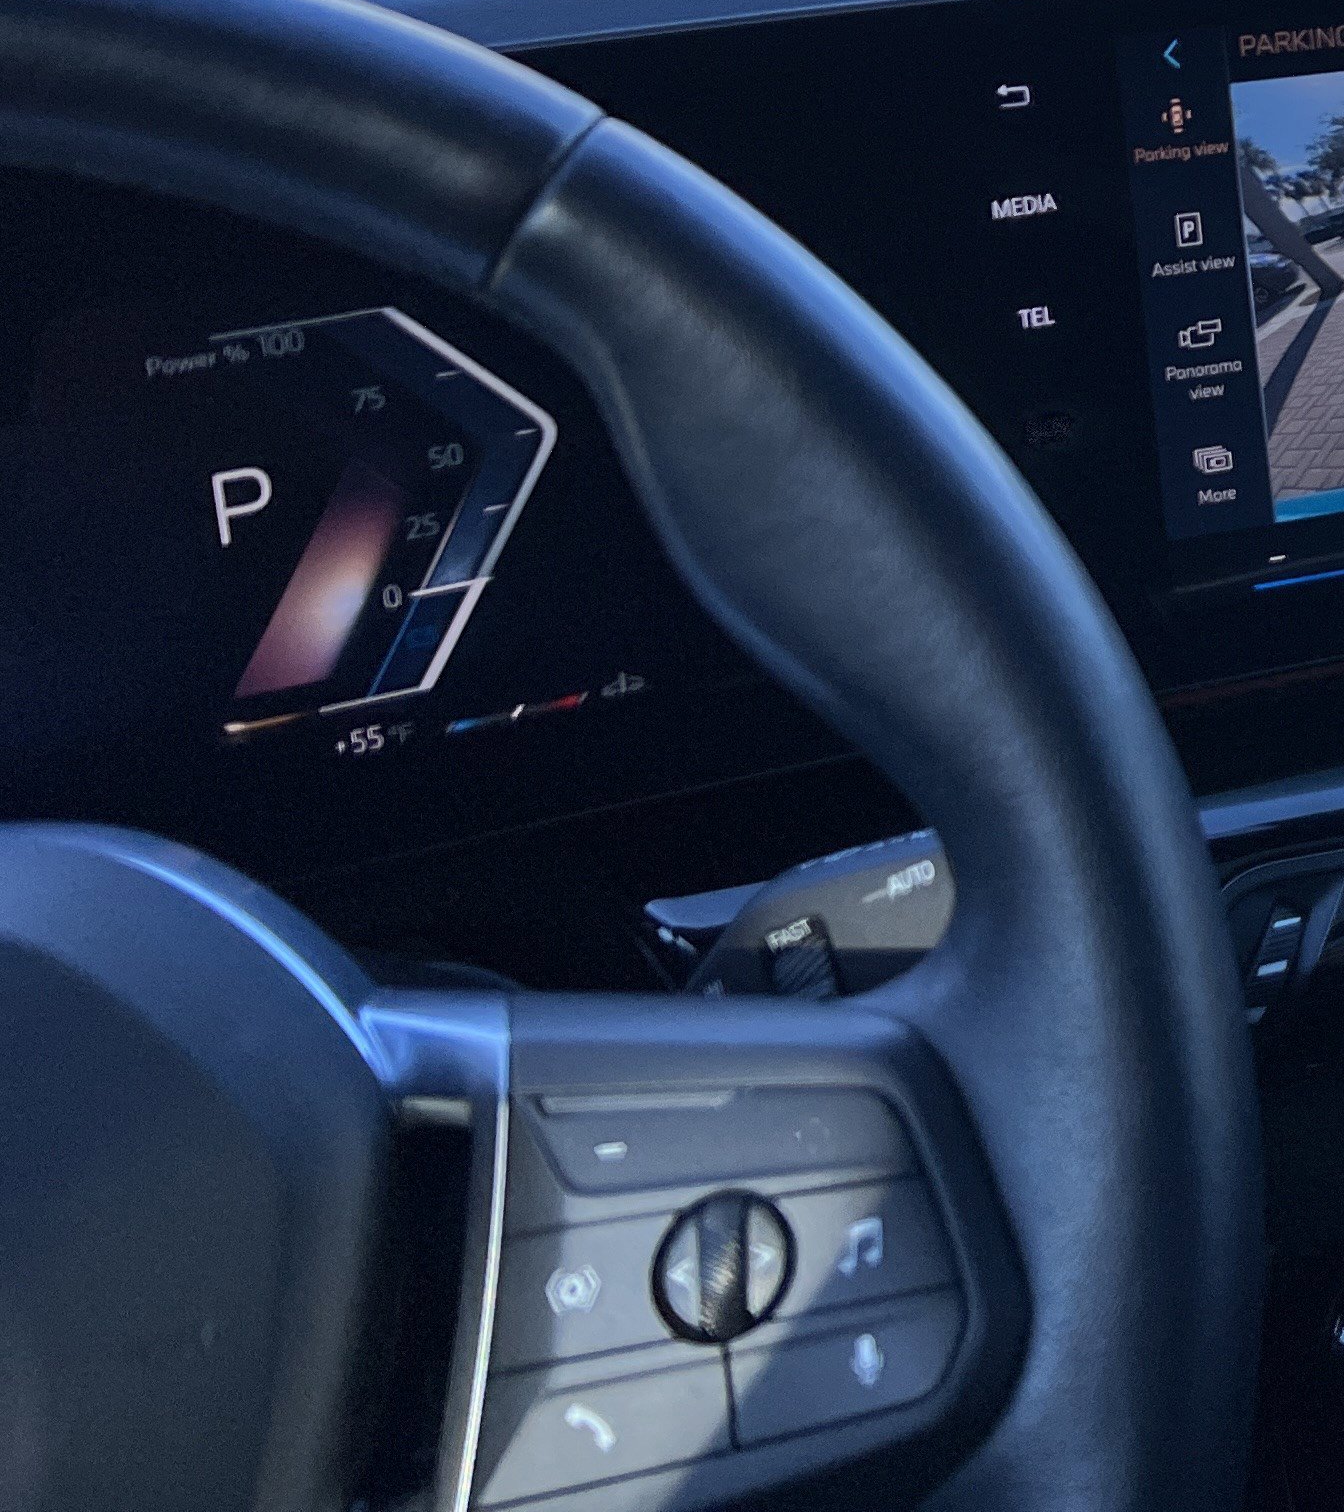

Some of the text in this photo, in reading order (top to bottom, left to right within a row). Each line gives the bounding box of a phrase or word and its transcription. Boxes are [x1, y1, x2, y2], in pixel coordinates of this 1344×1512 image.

[1134, 141, 1229, 163] Parking view
[991, 193, 1058, 219] MEDIA
[1151, 256, 1236, 278] Assist view
[1017, 305, 1056, 329] TEL
[145, 352, 217, 377] Power
[257, 330, 305, 357] 100
[1165, 360, 1243, 381] Panorama
[352, 386, 387, 414] 75
[1189, 384, 1225, 401] view
[428, 443, 464, 470] 50
[210, 466, 273, 547] P
[1198, 489, 1237, 505] More
[406, 513, 441, 541] 25
[382, 584, 403, 609] 0
[886, 859, 936, 899] AUTO
[765, 916, 812, 953] FAST
